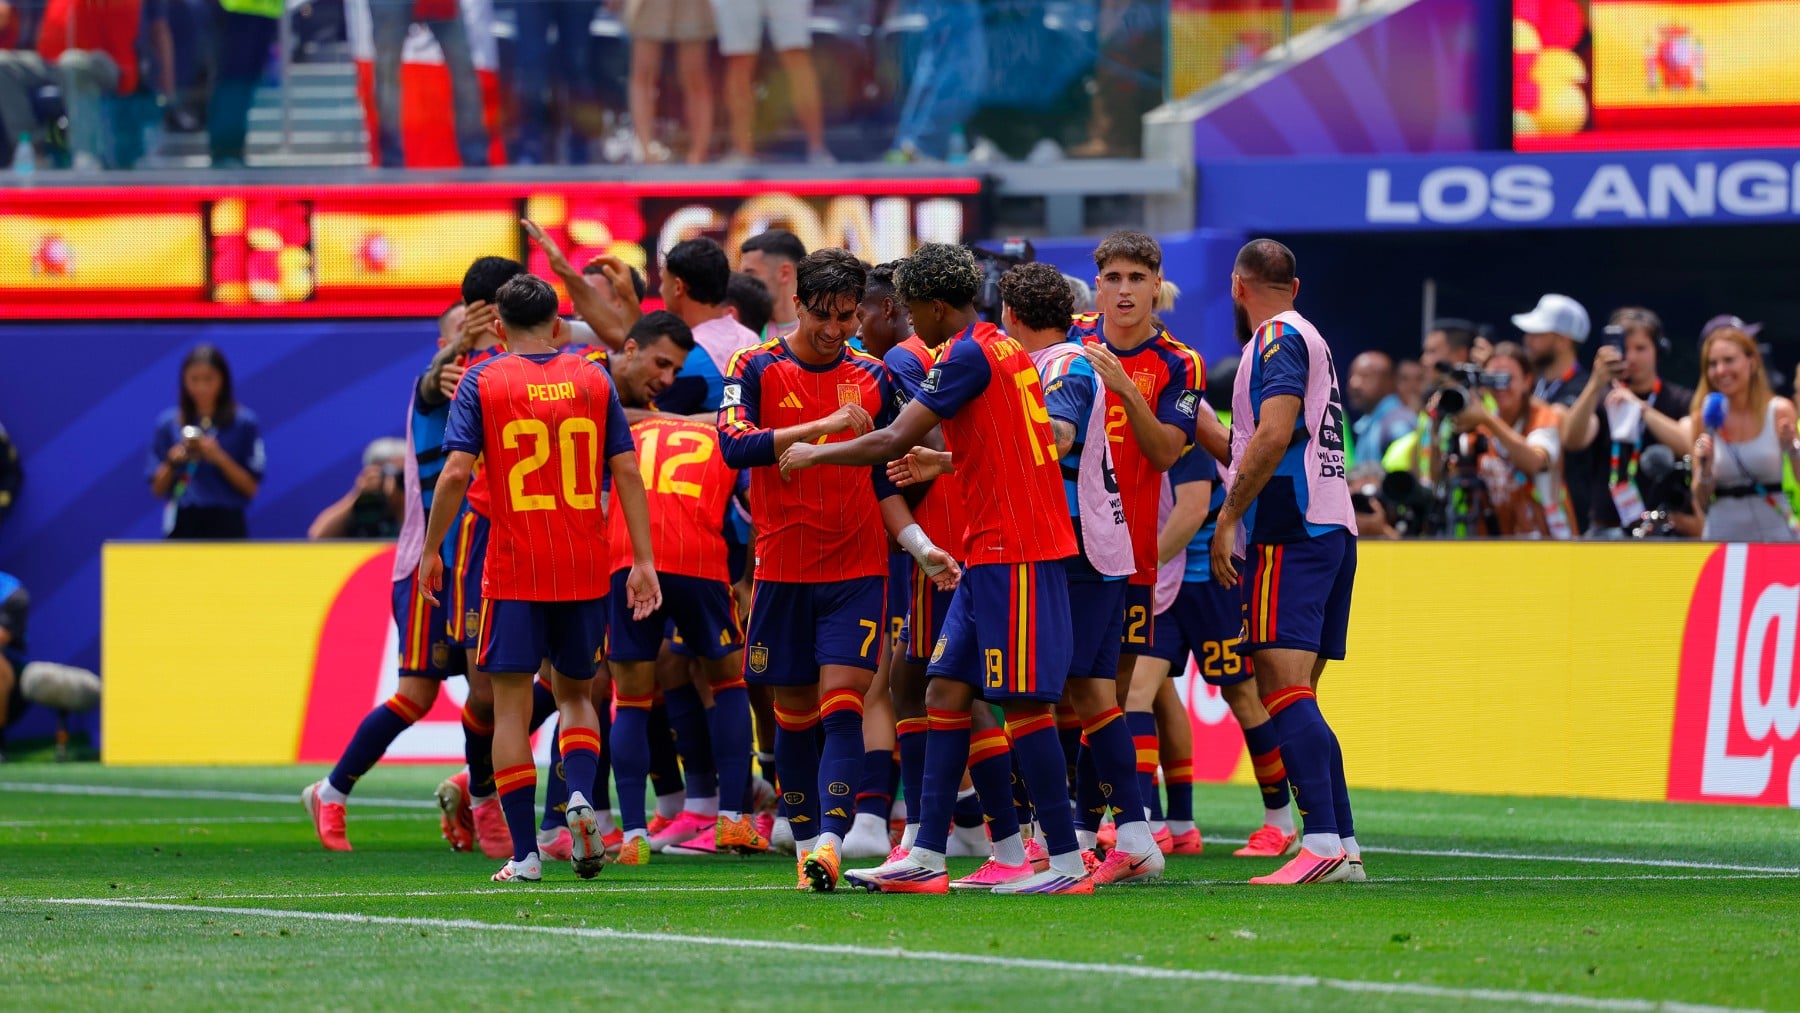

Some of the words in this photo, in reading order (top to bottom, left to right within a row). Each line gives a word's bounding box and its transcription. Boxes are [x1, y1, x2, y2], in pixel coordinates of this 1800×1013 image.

[1366, 166, 1555, 223] LOS
[1572, 160, 1800, 219] ANG
[527, 382, 576, 401] PEDRI
[502, 417, 597, 512] 20
[640, 428, 715, 498] 12
[859, 619, 877, 658] 7
[1202, 637, 1242, 676] 25
[984, 648, 1003, 688] 19
[1701, 543, 1800, 805] La
